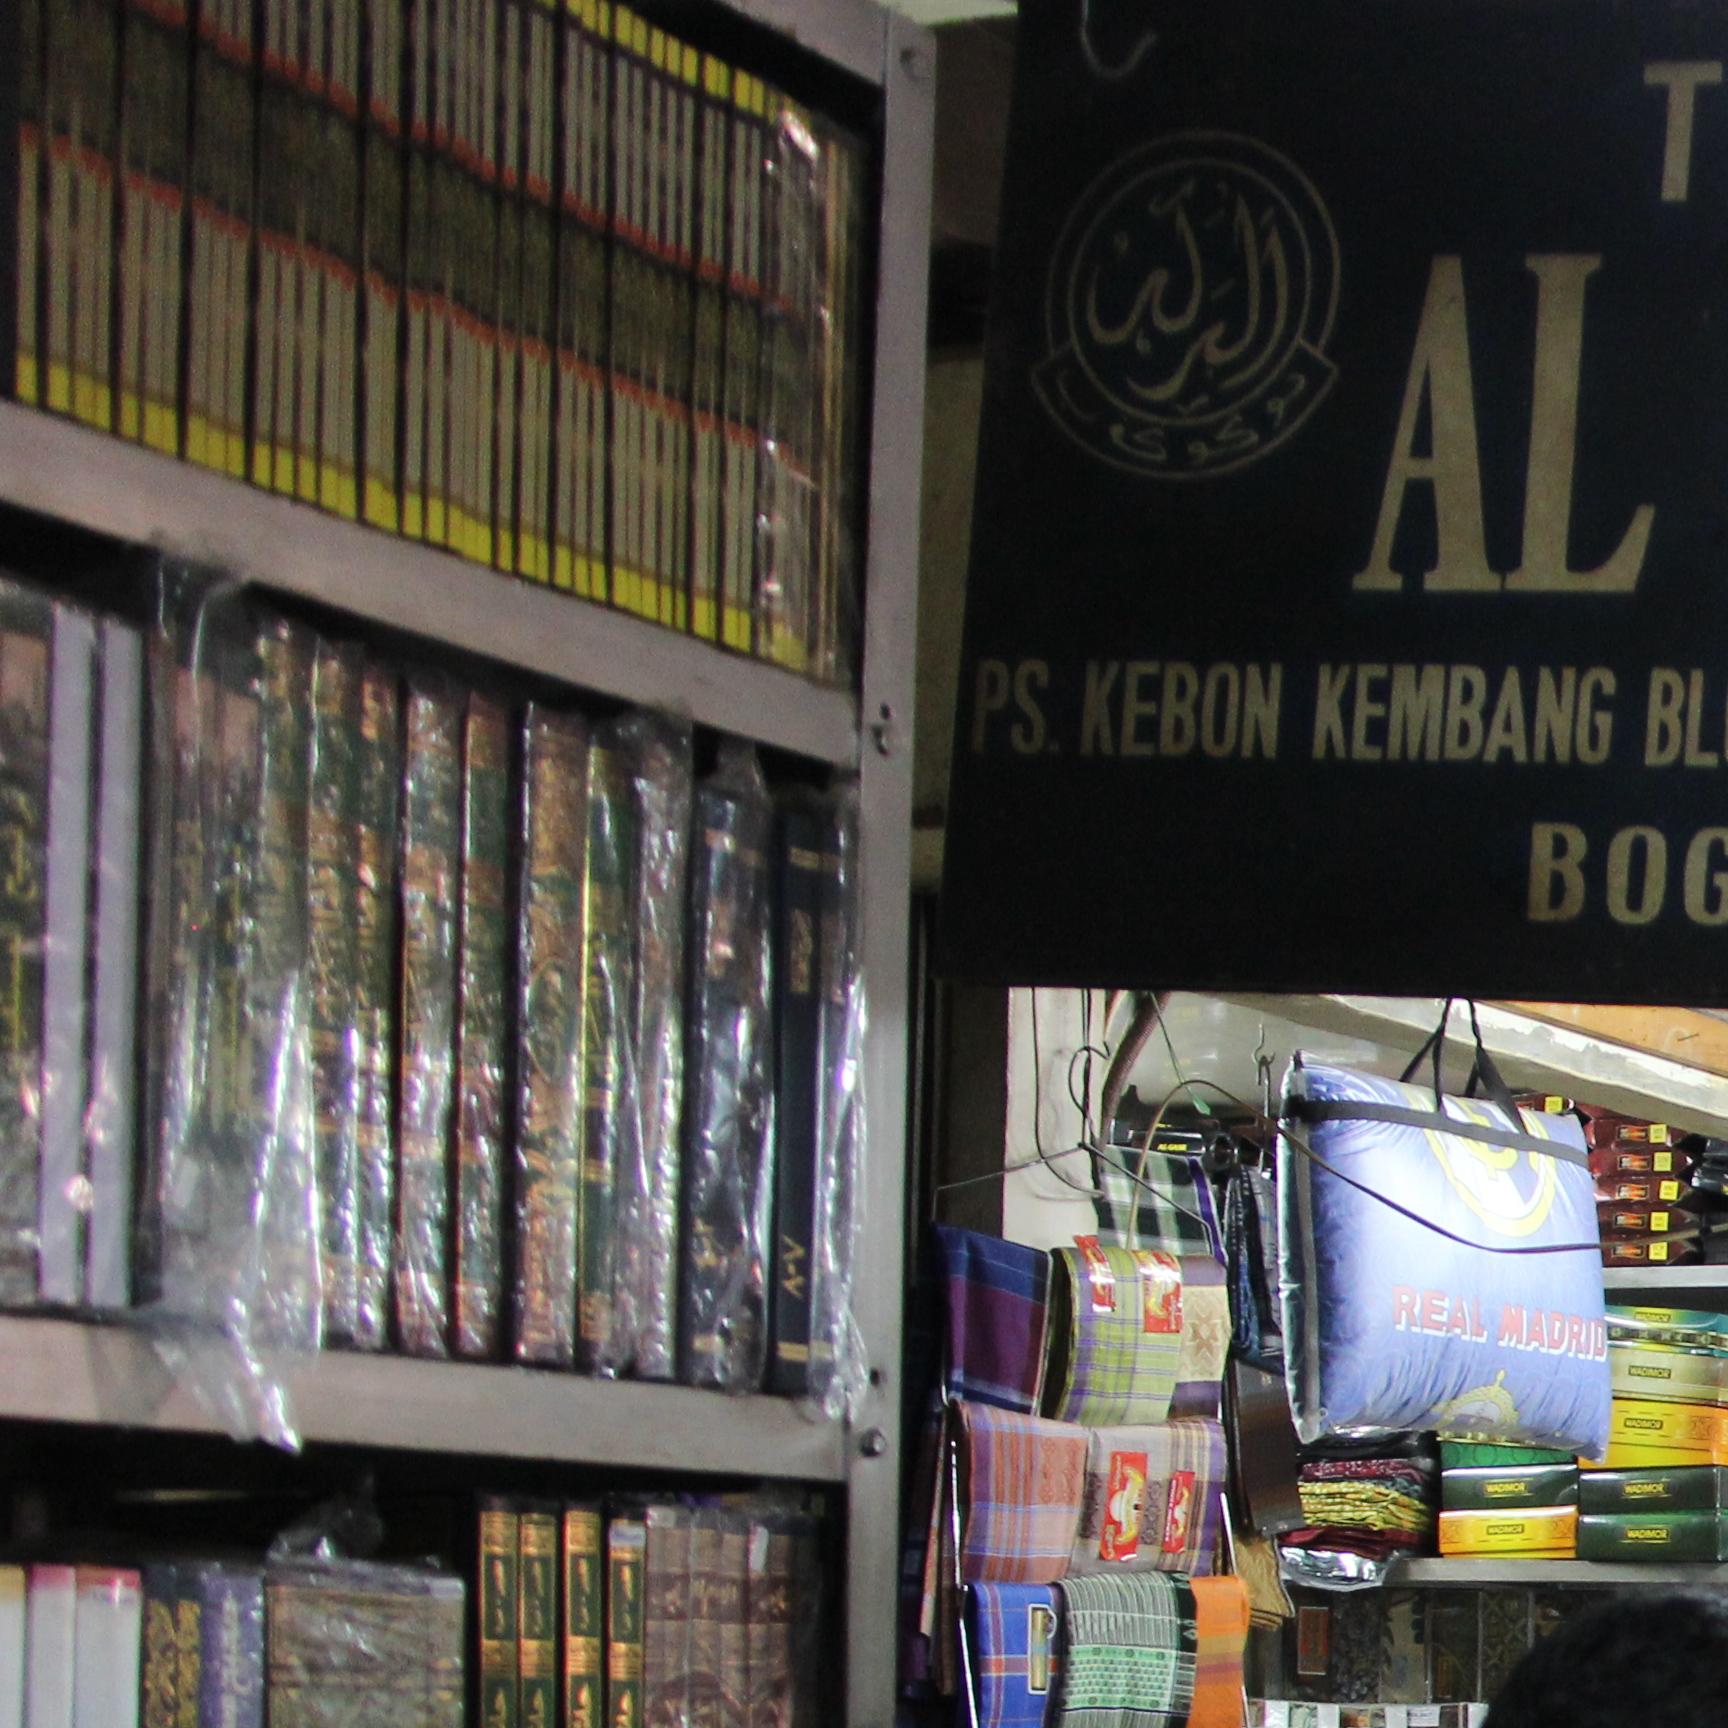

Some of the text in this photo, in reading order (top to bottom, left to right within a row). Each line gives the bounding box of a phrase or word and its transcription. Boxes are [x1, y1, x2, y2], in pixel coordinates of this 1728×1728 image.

[1352, 253, 1655, 594] AL
[970, 658, 1060, 757] PS.
[1078, 661, 1284, 758] KEBON
[1312, 663, 1618, 765] KEMBANG
[1391, 1284, 1607, 1362] REAL MADRID
[1629, 1366, 1672, 1379] WADIMOR
[1625, 1418, 1663, 1430] WADIMOR
[1485, 1482, 1527, 1493] WADIMOR
[1624, 1484, 1665, 1494] WADIMOR
[1487, 1524, 1524, 1534] WADIMOR
[1626, 1529, 1669, 1540] WADIMOR
